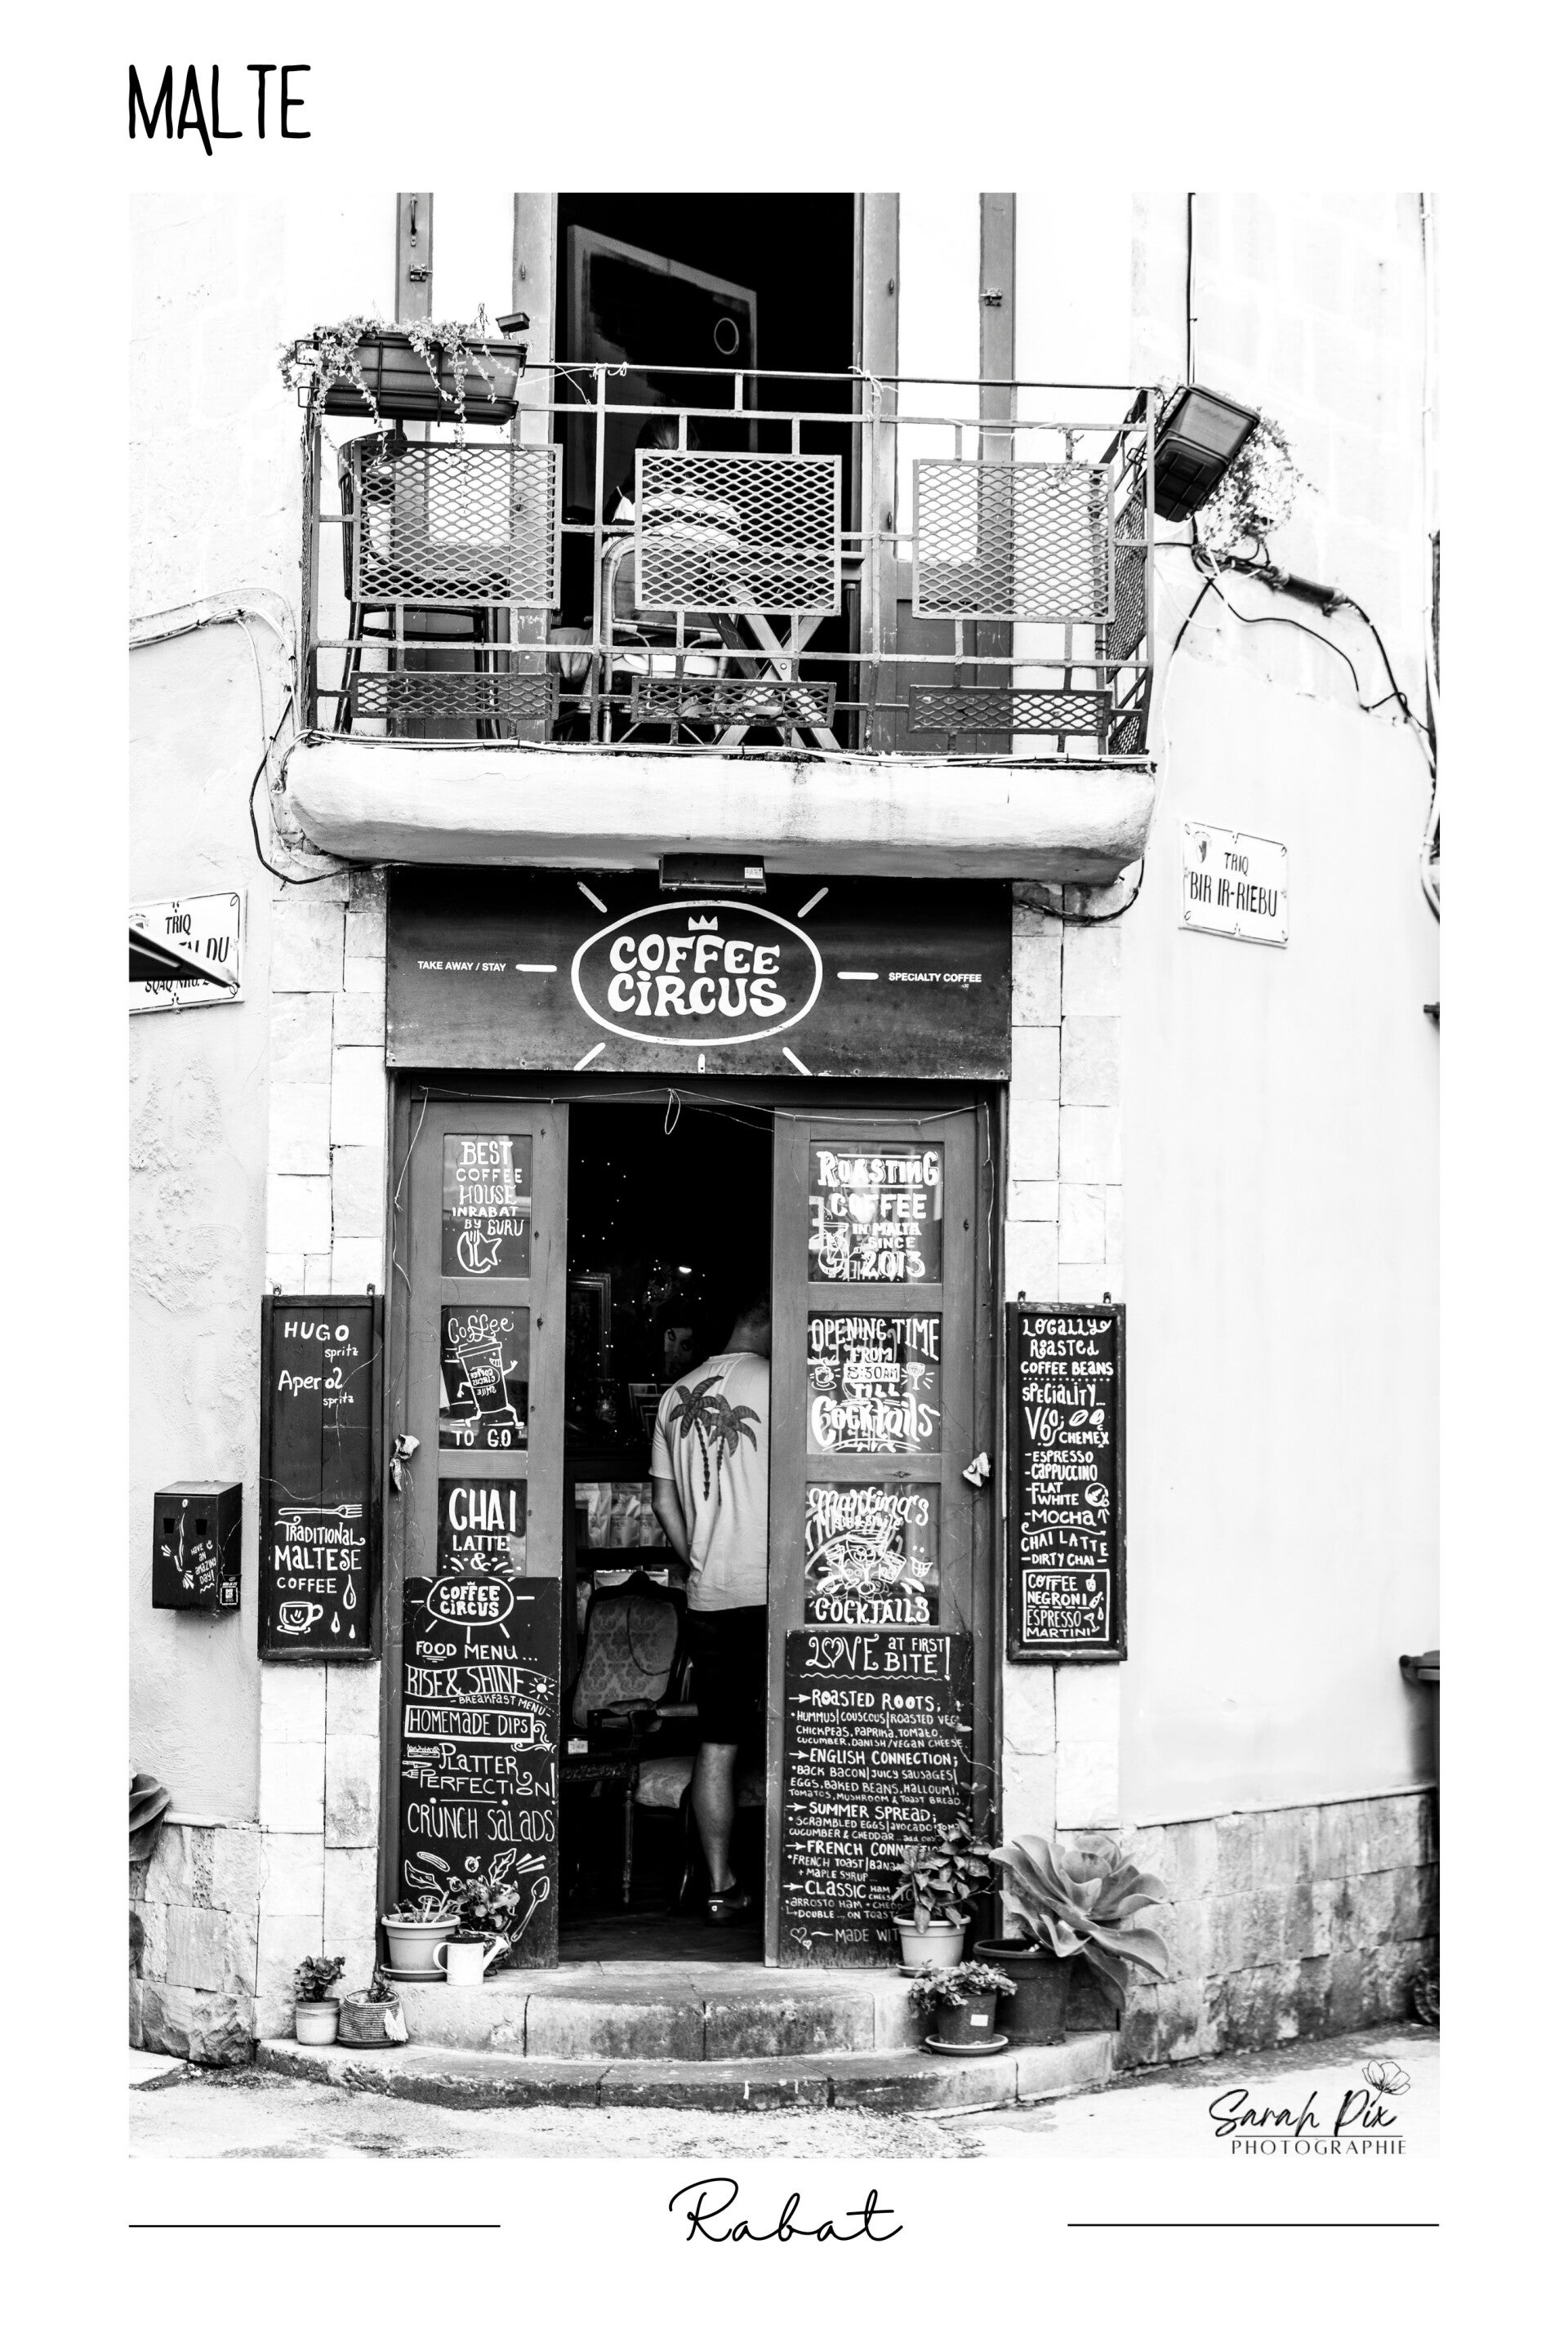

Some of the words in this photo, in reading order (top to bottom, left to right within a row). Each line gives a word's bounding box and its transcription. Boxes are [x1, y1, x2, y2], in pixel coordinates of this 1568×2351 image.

[1224, 852, 1249, 877] TRIQ
[1190, 871, 1212, 903] BIR
[1218, 878, 1277, 917] IR-RIEBU
[165, 914, 191, 936] TRIQ
[609, 933, 781, 975] COFFEE
[417, 960, 443, 970] TAKE
[445, 961, 474, 971] AWAY
[482, 962, 506, 972] STAY
[889, 972, 942, 982] SPECIALTY
[942, 973, 982, 983] COFFEE
[608, 970, 786, 1017] CIRCUS
[459, 1140, 514, 1166] BEST
[456, 1168, 523, 1183] COFFEE
[459, 1184, 517, 1205] HOUSE
[831, 1193, 928, 1219] COFFEE
[464, 1218, 482, 1229] BY
[487, 1219, 524, 1236] GURU
[852, 1222, 869, 1235] IN
[872, 1222, 922, 1236] MALTA
[867, 1236, 916, 1249] SINCE
[861, 1249, 926, 1280] 2013
[284, 1321, 350, 1342] HUGO
[448, 1313, 514, 1344] Coffee
[811, 1317, 887, 1352] OPENING
[891, 1318, 939, 1361] TIME
[324, 1343, 359, 1363] spritz
[851, 1347, 893, 1363] FROM
[1020, 1360, 1068, 1375] COFFEE
[278, 1366, 343, 1396] Aperol
[850, 1382, 900, 1399] TILL
[323, 1391, 354, 1409] spritz
[451, 1430, 474, 1446] TO
[487, 1429, 511, 1448] GO
[1036, 1493, 1080, 1506] WHITE
[448, 1487, 516, 1533] CHAI
[452, 1534, 510, 1552] LATTE
[1021, 1531, 1054, 1552] CHAI
[1059, 1530, 1109, 1557] LATTE
[470, 1552, 492, 1572] &
[1031, 1552, 1065, 1567] DIRTY
[1067, 1553, 1095, 1566] CHAI
[276, 1576, 337, 1593] COFFEE
[1027, 1574, 1078, 1592] COFFEE
[439, 1585, 501, 1602] COFFEE
[1027, 1591, 1087, 1606] NEGRONI
[439, 1599, 500, 1618] CIRCUS
[815, 1596, 930, 1624] COCKTAILS
[1027, 1609, 1082, 1628] ESPRESSO
[1027, 1627, 1091, 1638] MARTINI
[416, 1641, 457, 1656] FOOD
[911, 1637, 944, 1653] FIRST
[408, 1667, 443, 1697] RISE
[446, 1668, 467, 1697] &
[466, 1665, 524, 1695] SHINE
[518, 1699, 547, 1716] MENU
[498, 1715, 528, 1736] DIPS
[809, 1748, 866, 1765] ENGLISH
[871, 1769, 899, 1779] JUICY
[836, 1792, 889, 1802] MUSHROOM
[808, 1801, 870, 1819] SUMMER
[408, 1803, 479, 1840] CRUNCH
[860, 1820, 885, 1830] EGGS
[788, 1828, 841, 1839] CUCUMBER
[807, 1839, 864, 1856] FRENCH
[792, 1854, 831, 1868] FRENCH
[847, 1910, 861, 1919] ON
